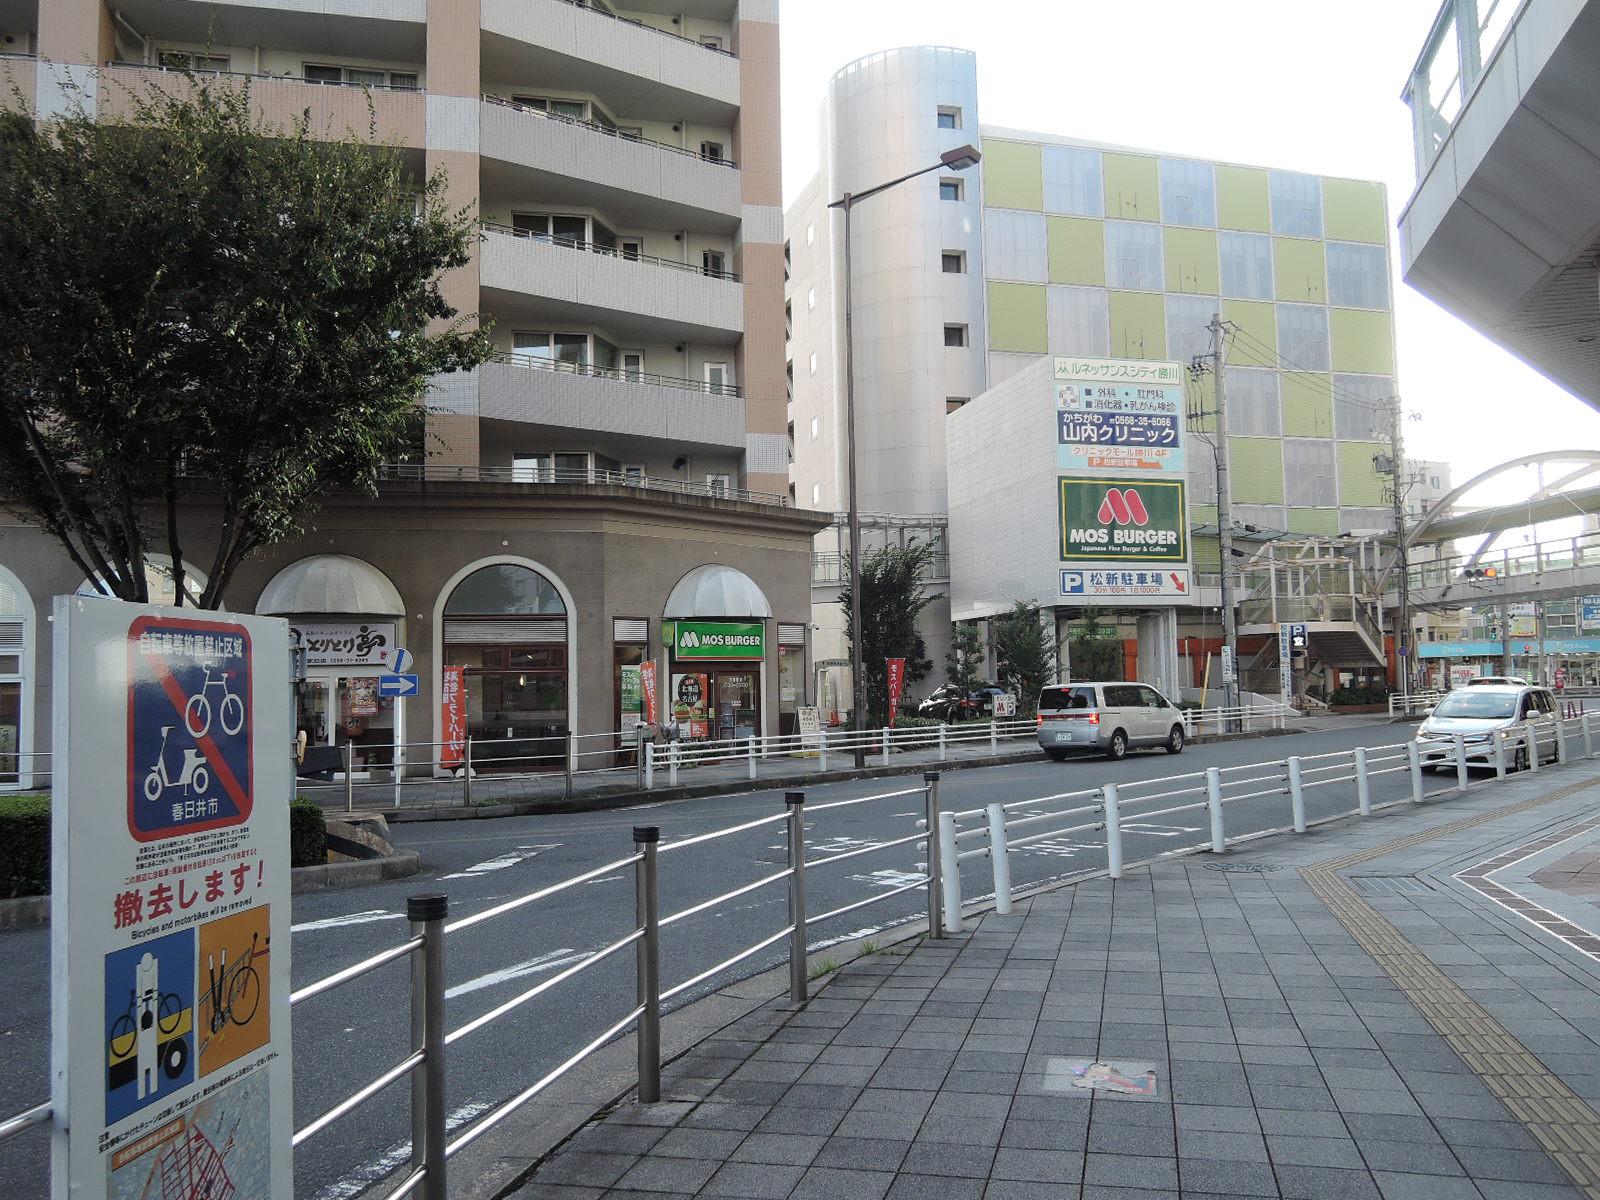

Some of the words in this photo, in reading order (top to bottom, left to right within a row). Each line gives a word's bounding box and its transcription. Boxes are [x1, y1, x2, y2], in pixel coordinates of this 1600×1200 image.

[1071, 362, 1178, 380] ルネッサンスシティ勝川
[1063, 413, 1103, 424] かちがわ
[1063, 423, 1176, 443] 山内クリニック
[1093, 458, 1100, 466] P
[1070, 528, 1109, 543] MOS
[1114, 529, 1177, 545] BURGER
[1064, 573, 1082, 592] P
[1090, 573, 1164, 586] 松新駐車場
[140, 631, 243, 658] 自転車等放置禁止区域
[701, 634, 724, 645] MOS
[724, 635, 761, 646] BURGER
[889, 664, 897, 712] モスバーガー
[172, 798, 219, 822] 春日井市
[131, 925, 160, 940] Bicycles
[161, 920, 173, 931] and
[174, 910, 209, 927] motorbikes
[210, 905, 220, 915] will
[228, 896, 252, 910] removed
